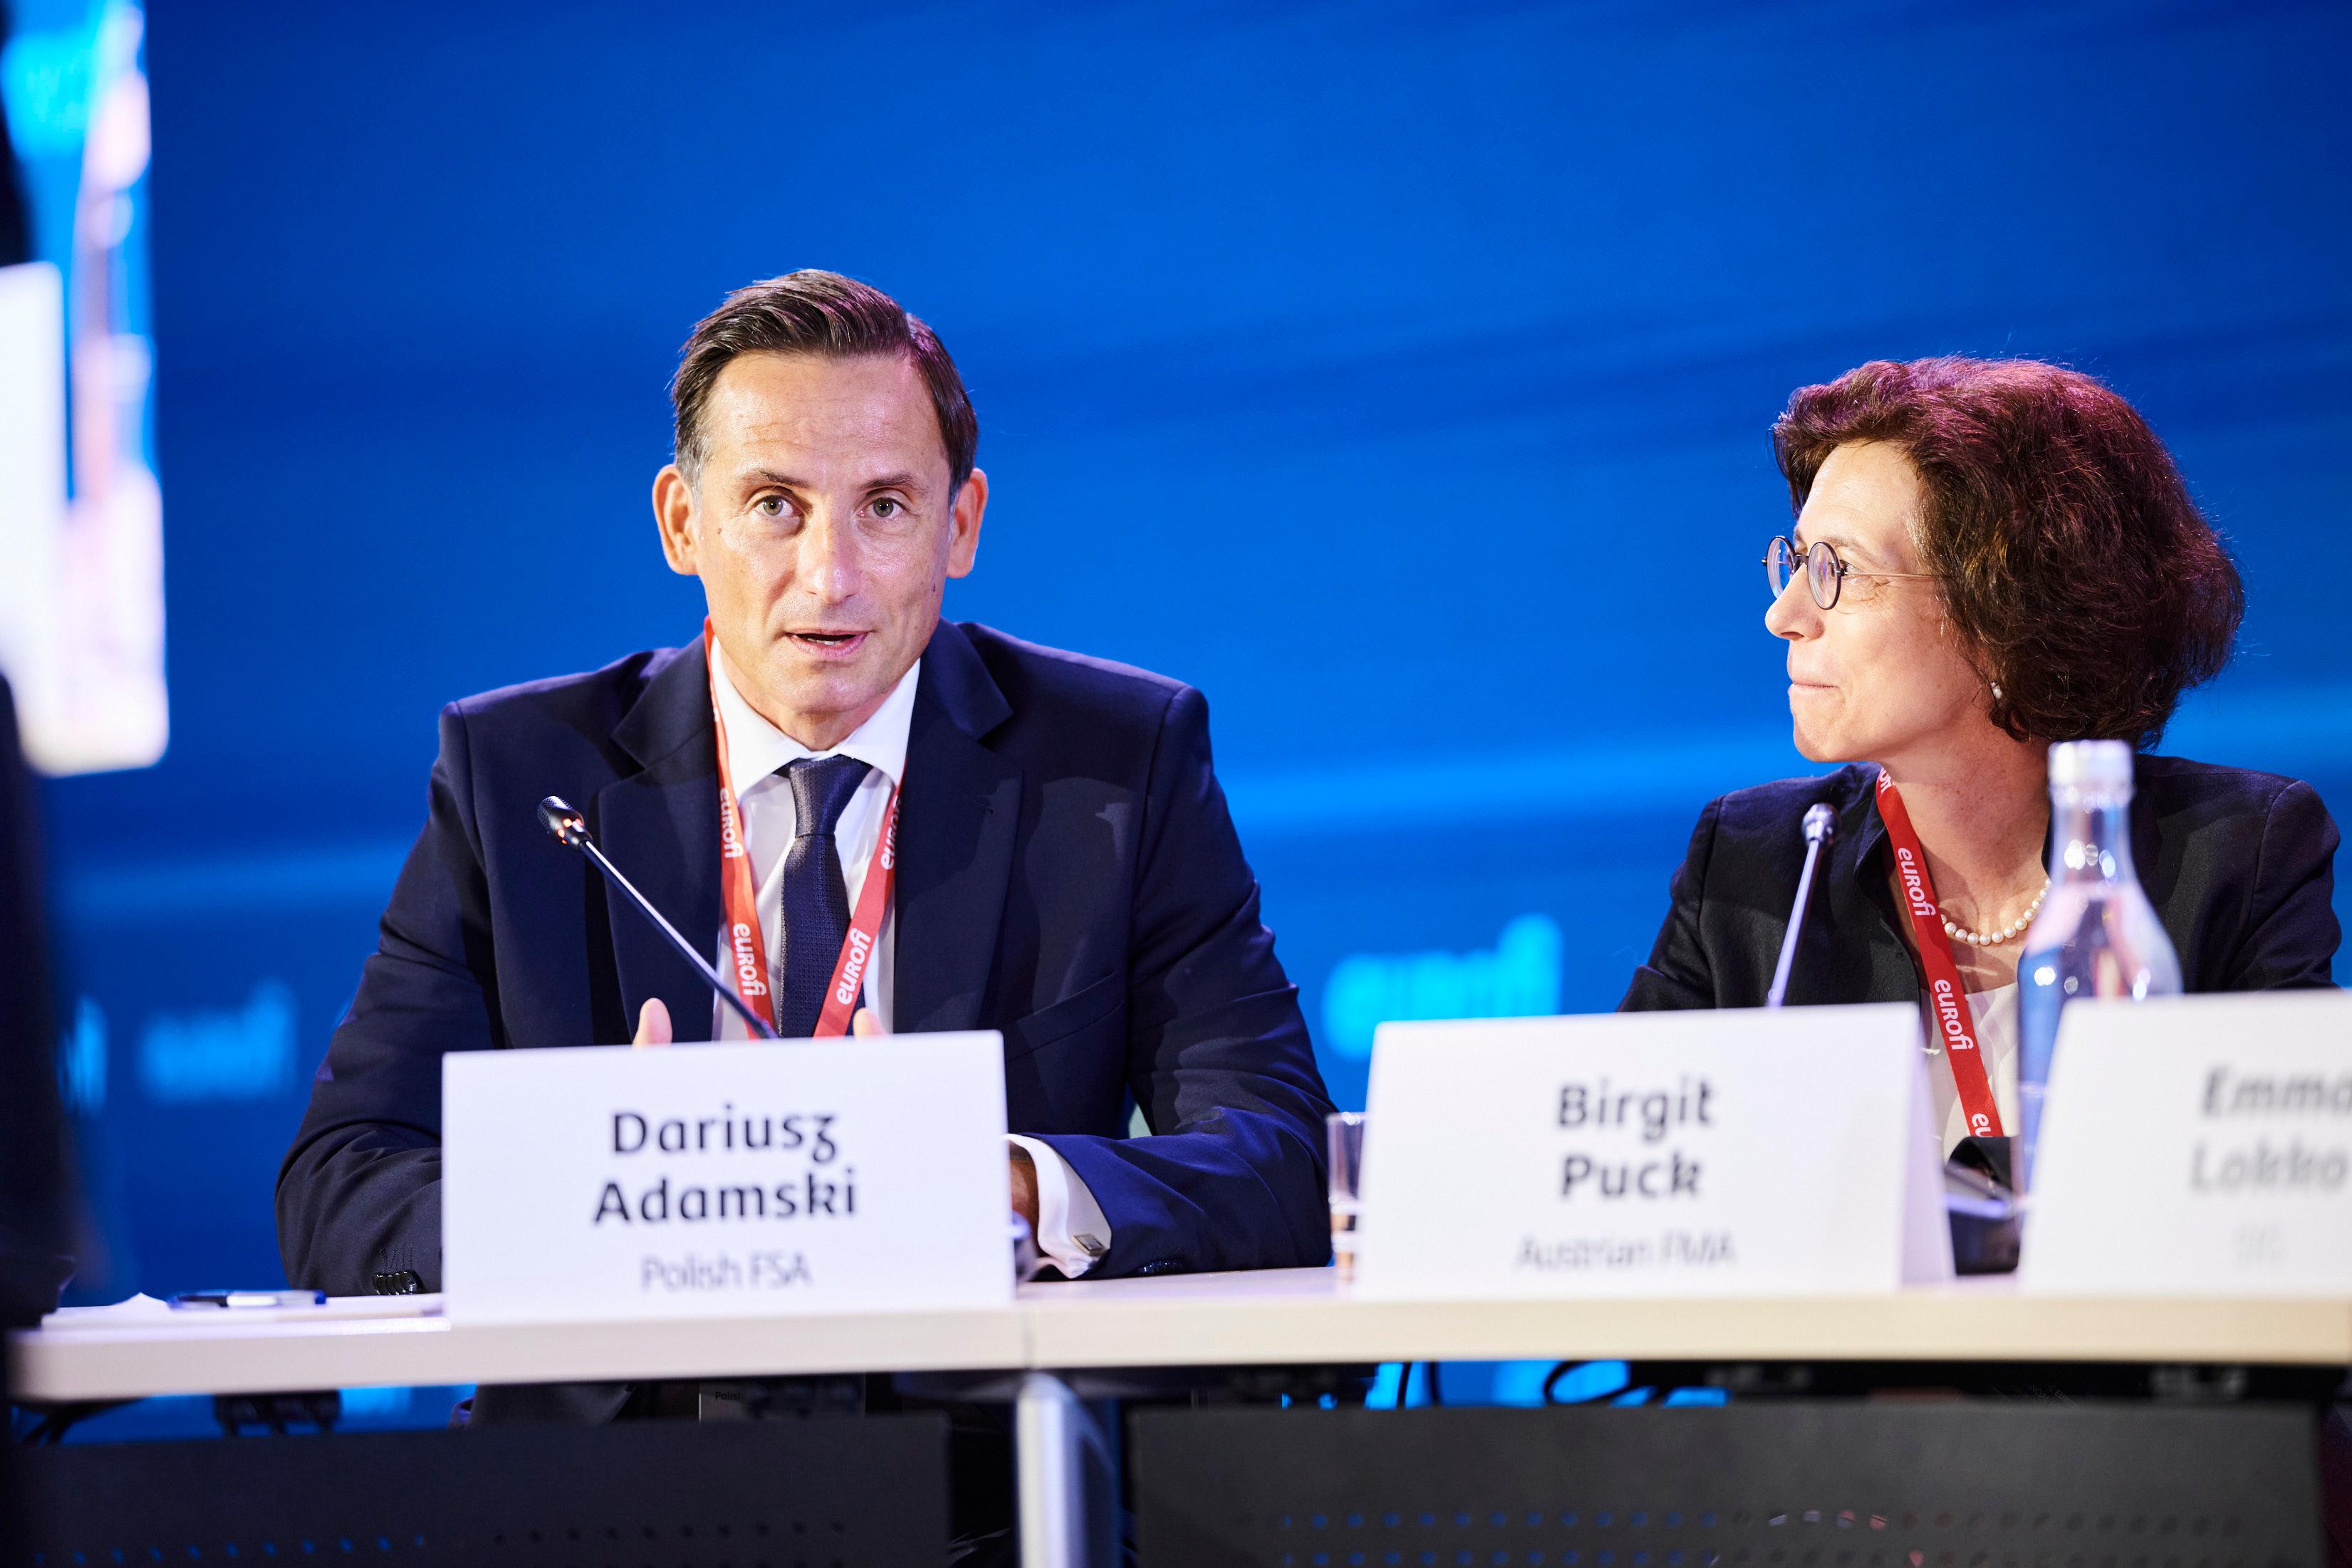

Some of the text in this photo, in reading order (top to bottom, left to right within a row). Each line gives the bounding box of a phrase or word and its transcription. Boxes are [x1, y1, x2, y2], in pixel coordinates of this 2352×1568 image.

[612, 1103, 838, 1164] Dariusz
[1556, 1078, 1713, 1144] Birgit
[593, 1167, 856, 1225] Adamski
[1560, 1150, 1702, 1200] Puck
[640, 1250, 813, 1292] Polish FSA
[1514, 1230, 1737, 1272] Austrian FMA
